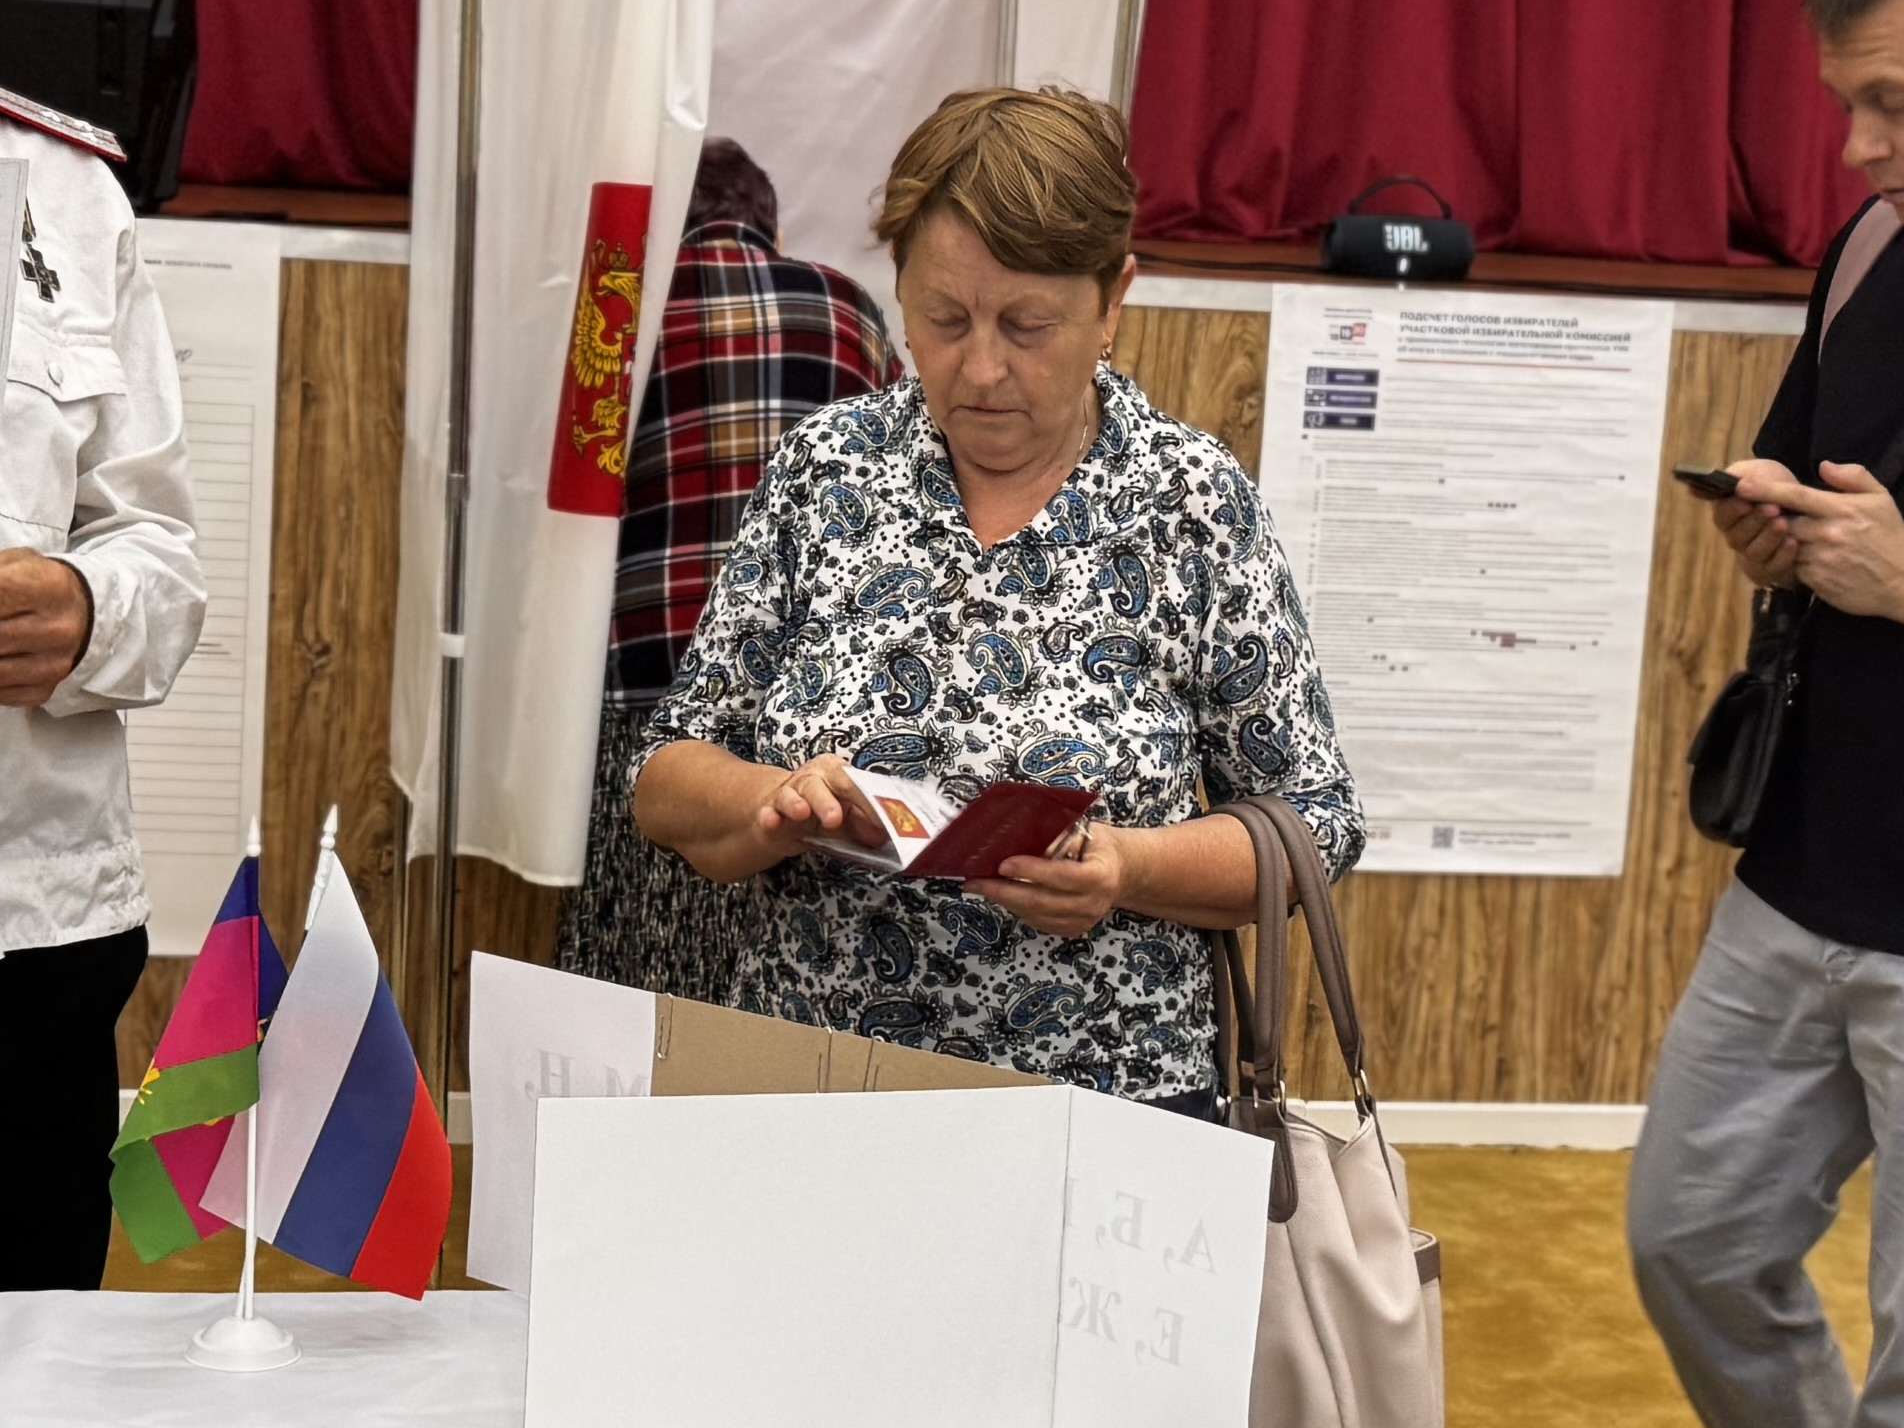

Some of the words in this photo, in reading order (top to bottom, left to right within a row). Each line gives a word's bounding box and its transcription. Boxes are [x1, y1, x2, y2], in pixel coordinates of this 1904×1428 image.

[1399, 311, 1449, 324] ПОДСЧЕТ
[1451, 313, 1500, 325] ГОЛОСОВ
[1504, 316, 1578, 329] ИЗБИРАТЕЛЕЙ
[1399, 324, 1469, 336] УЧАСТКОВОЙ
[1472, 328, 1563, 341] ИЗБИРАТЕЛЬНОЙ
[1565, 331, 1631, 343] КОМИССИЕЙ
